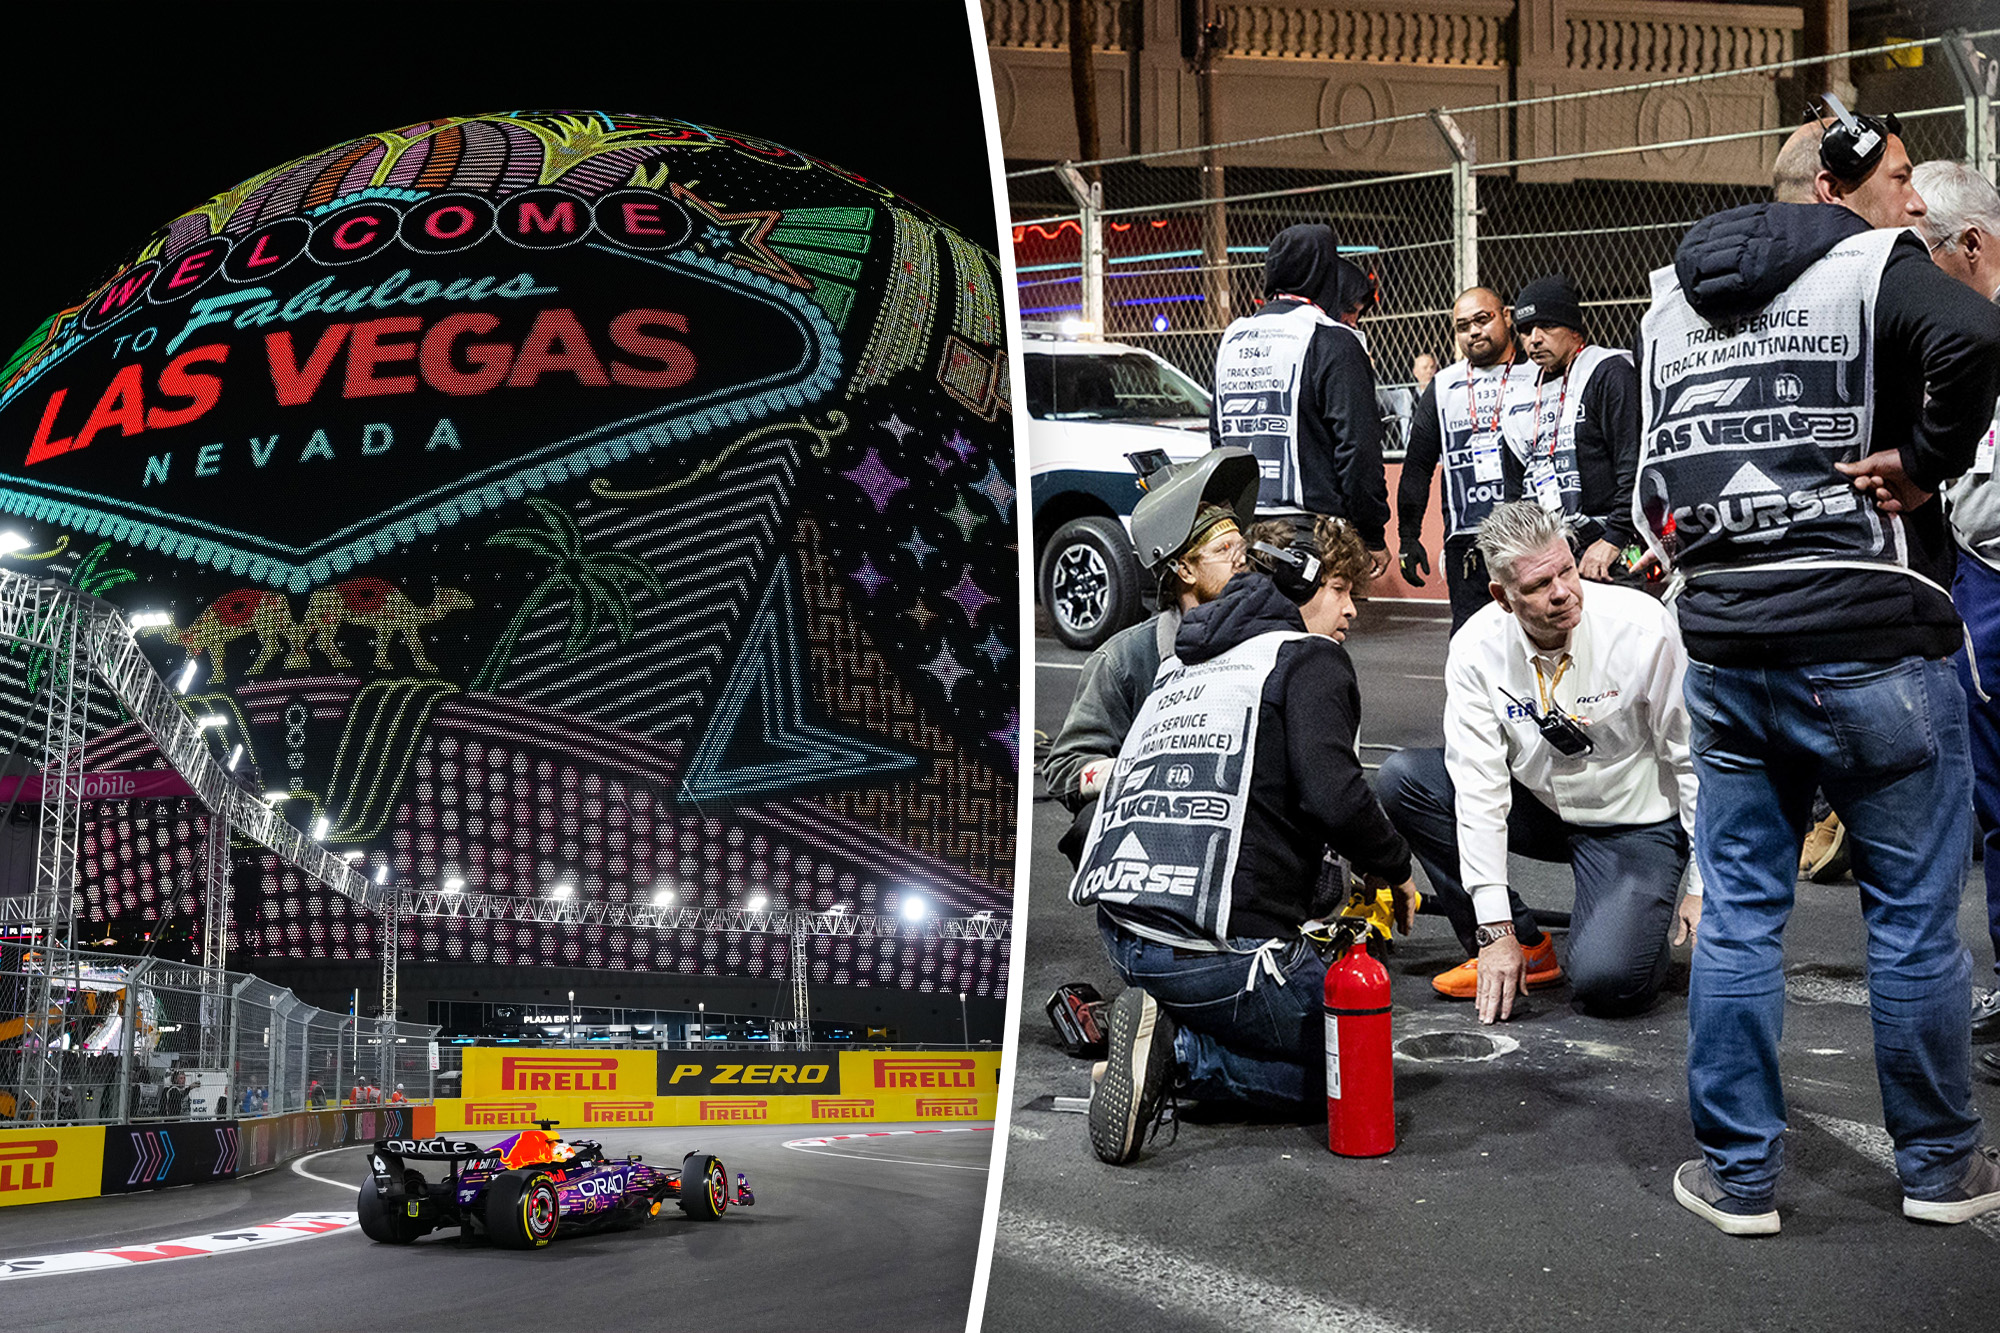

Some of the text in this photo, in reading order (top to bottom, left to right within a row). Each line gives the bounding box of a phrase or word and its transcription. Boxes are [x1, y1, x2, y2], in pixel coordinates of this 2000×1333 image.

[99, 201, 668, 317] WELCOME
[112, 269, 558, 358] TO Fabulous
[1686, 309, 1809, 348] TRACK SERVICE
[24, 308, 697, 466] LAS VEGAS
[142, 418, 462, 487] NEVADA
[1674, 483, 1857, 535] COURSE
[1577, 690, 1619, 704] ACCUS
[1160, 713, 1208, 733] SERVICE
[1081, 860, 1199, 899] COURSE
[523, 1015, 553, 1024] PLAZA
[502, 1057, 618, 1091] PIRELLI
[668, 1064, 829, 1084] P ZERO
[873, 1059, 976, 1088] PIRELLI
[465, 1103, 537, 1125] PIRELLI
[584, 1101, 655, 1122] PIRELLI
[700, 1100, 768, 1121] PIRELLI
[811, 1099, 874, 1119] PIRELLI
[916, 1098, 978, 1117] PIRELLI
[387, 1141, 467, 1154] ORACLE
